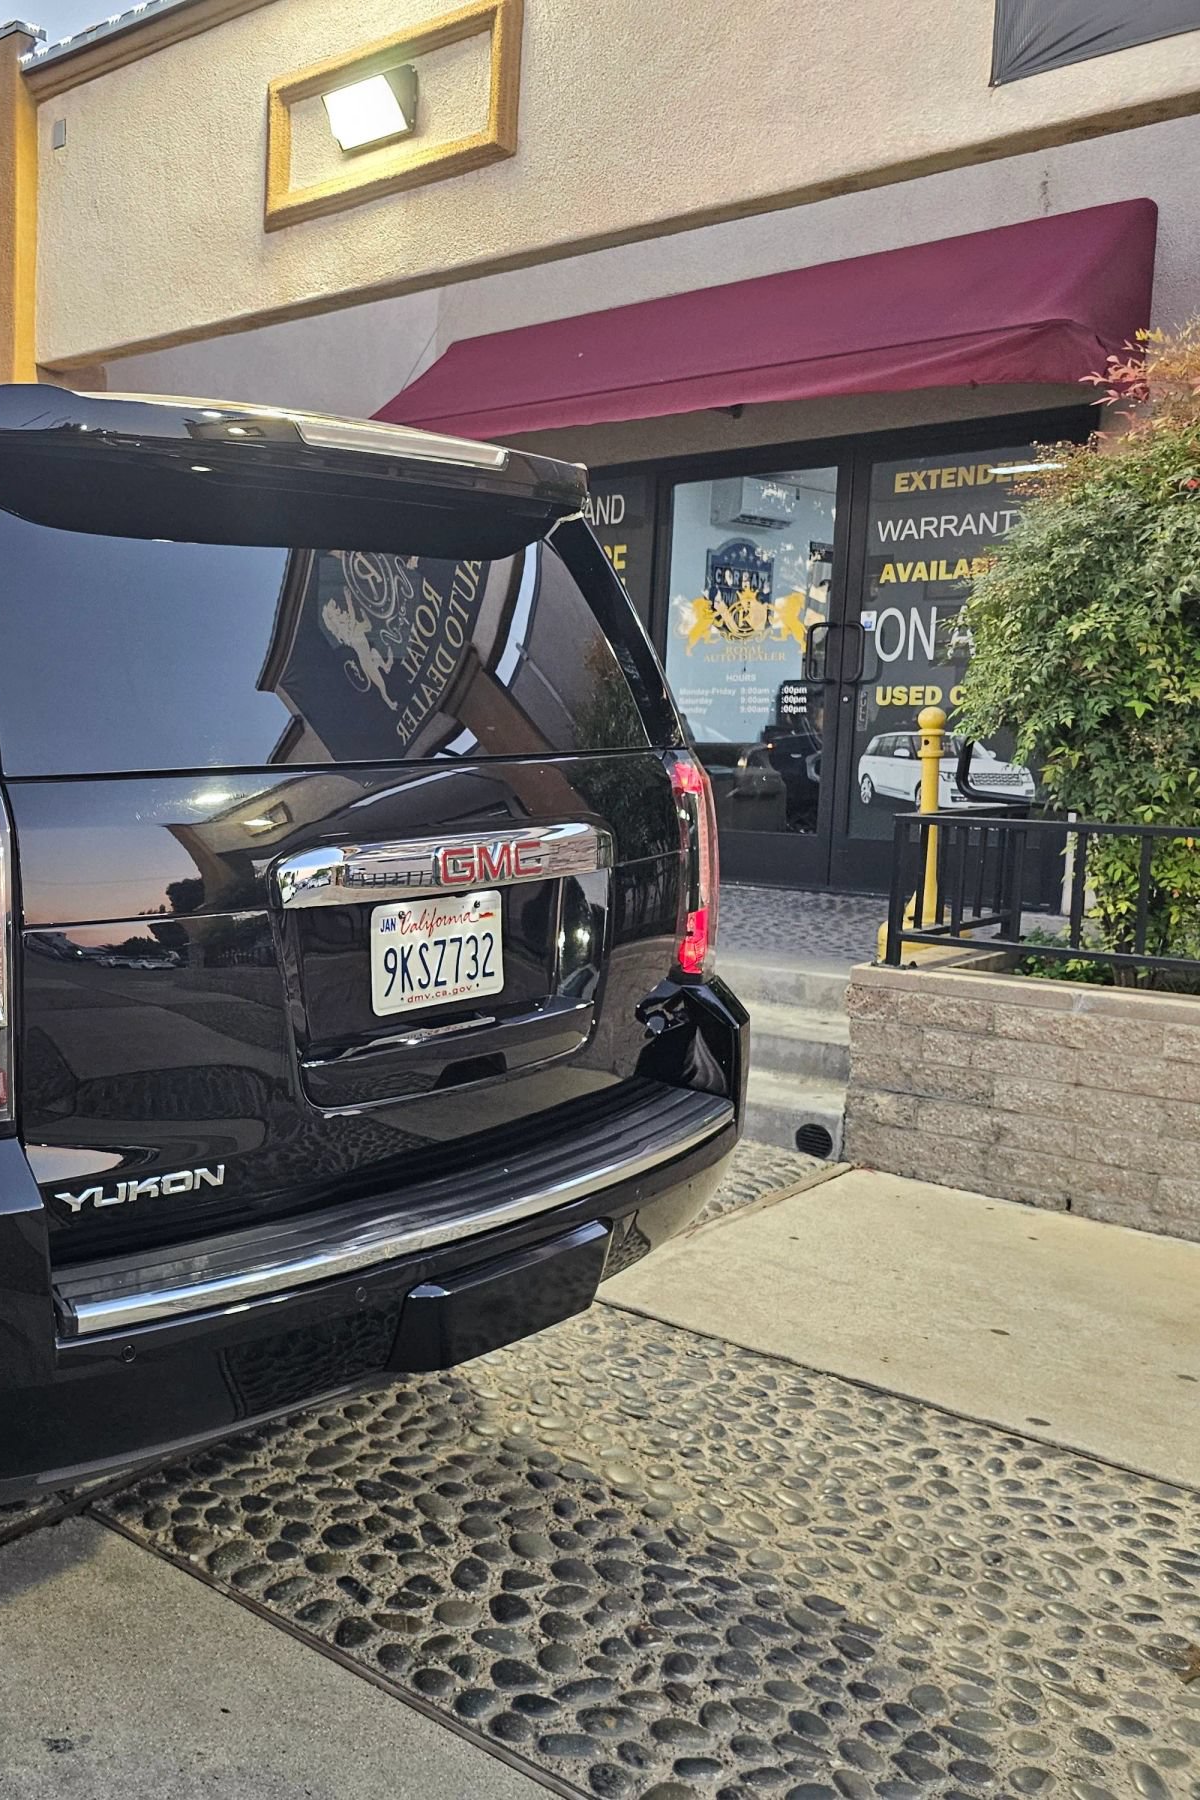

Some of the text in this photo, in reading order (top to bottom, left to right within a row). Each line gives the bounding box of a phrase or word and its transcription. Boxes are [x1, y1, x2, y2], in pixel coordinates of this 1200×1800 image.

[877, 509, 1018, 542] WARRANT
[875, 606, 937, 662] ON
[726, 673, 757, 682] HOURS
[780, 685, 808, 695] :00pm
[780, 695, 808, 704] :00pm
[875, 685, 943, 706] USED
[780, 704, 808, 715] :00pm
[438, 840, 544, 885] GMC
[380, 907, 479, 937] JAN California
[383, 932, 495, 997] 9KSZ732
[407, 984, 473, 1004] dmv.ca.gov
[54, 1164, 225, 1212] YUKON
